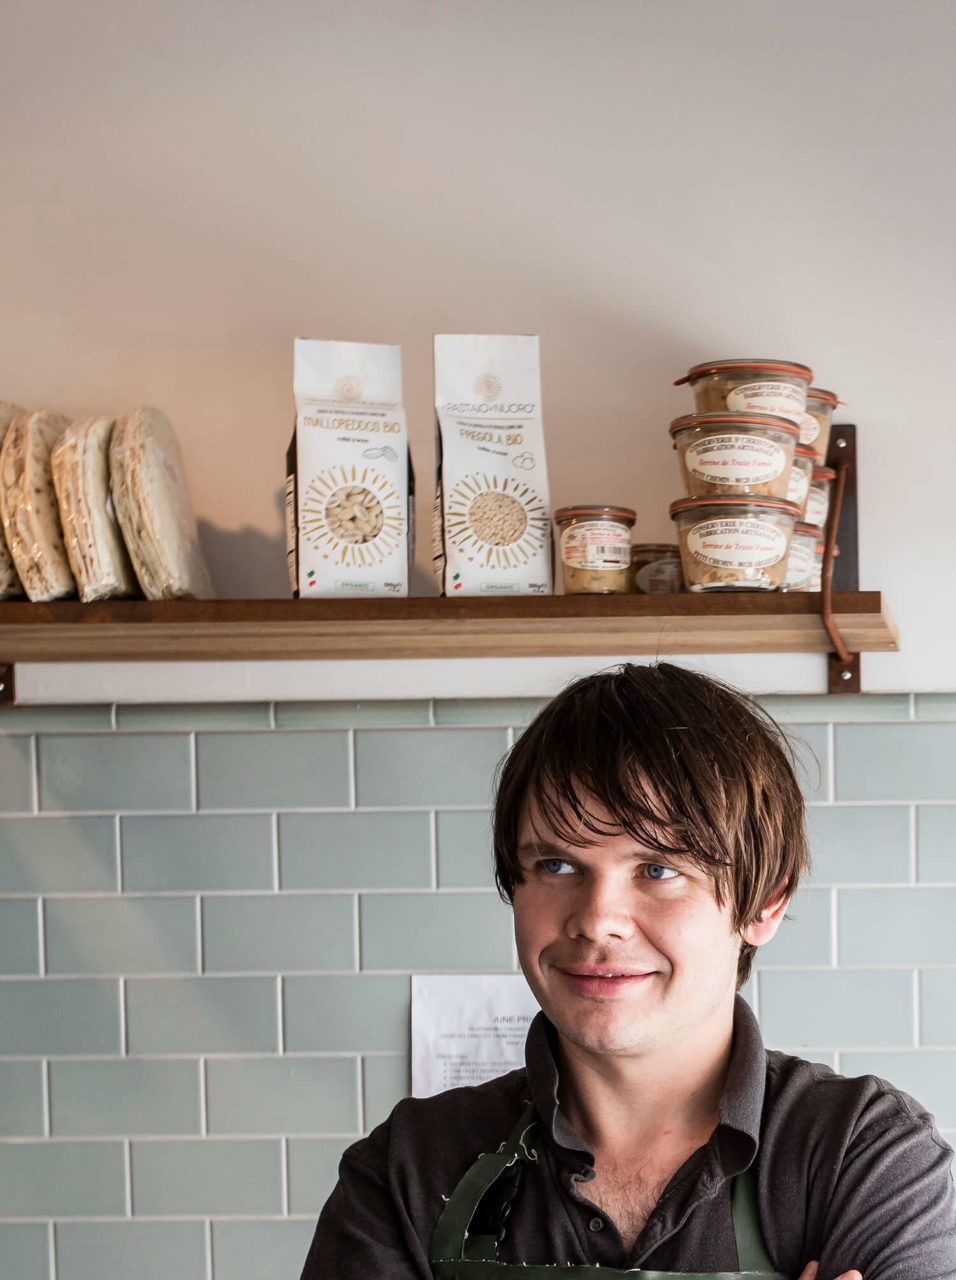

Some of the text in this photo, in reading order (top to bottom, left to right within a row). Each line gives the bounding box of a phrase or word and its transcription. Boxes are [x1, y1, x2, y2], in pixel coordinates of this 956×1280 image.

[383, 421, 401, 434] BIO
[459, 428, 524, 446] FREGOLA BIO
[696, 444, 735, 456] FABRICATION
[692, 520, 736, 535] CONSERVERIE
[699, 528, 739, 539] FABRICATION
[492, 1016, 514, 1024] JUNE
